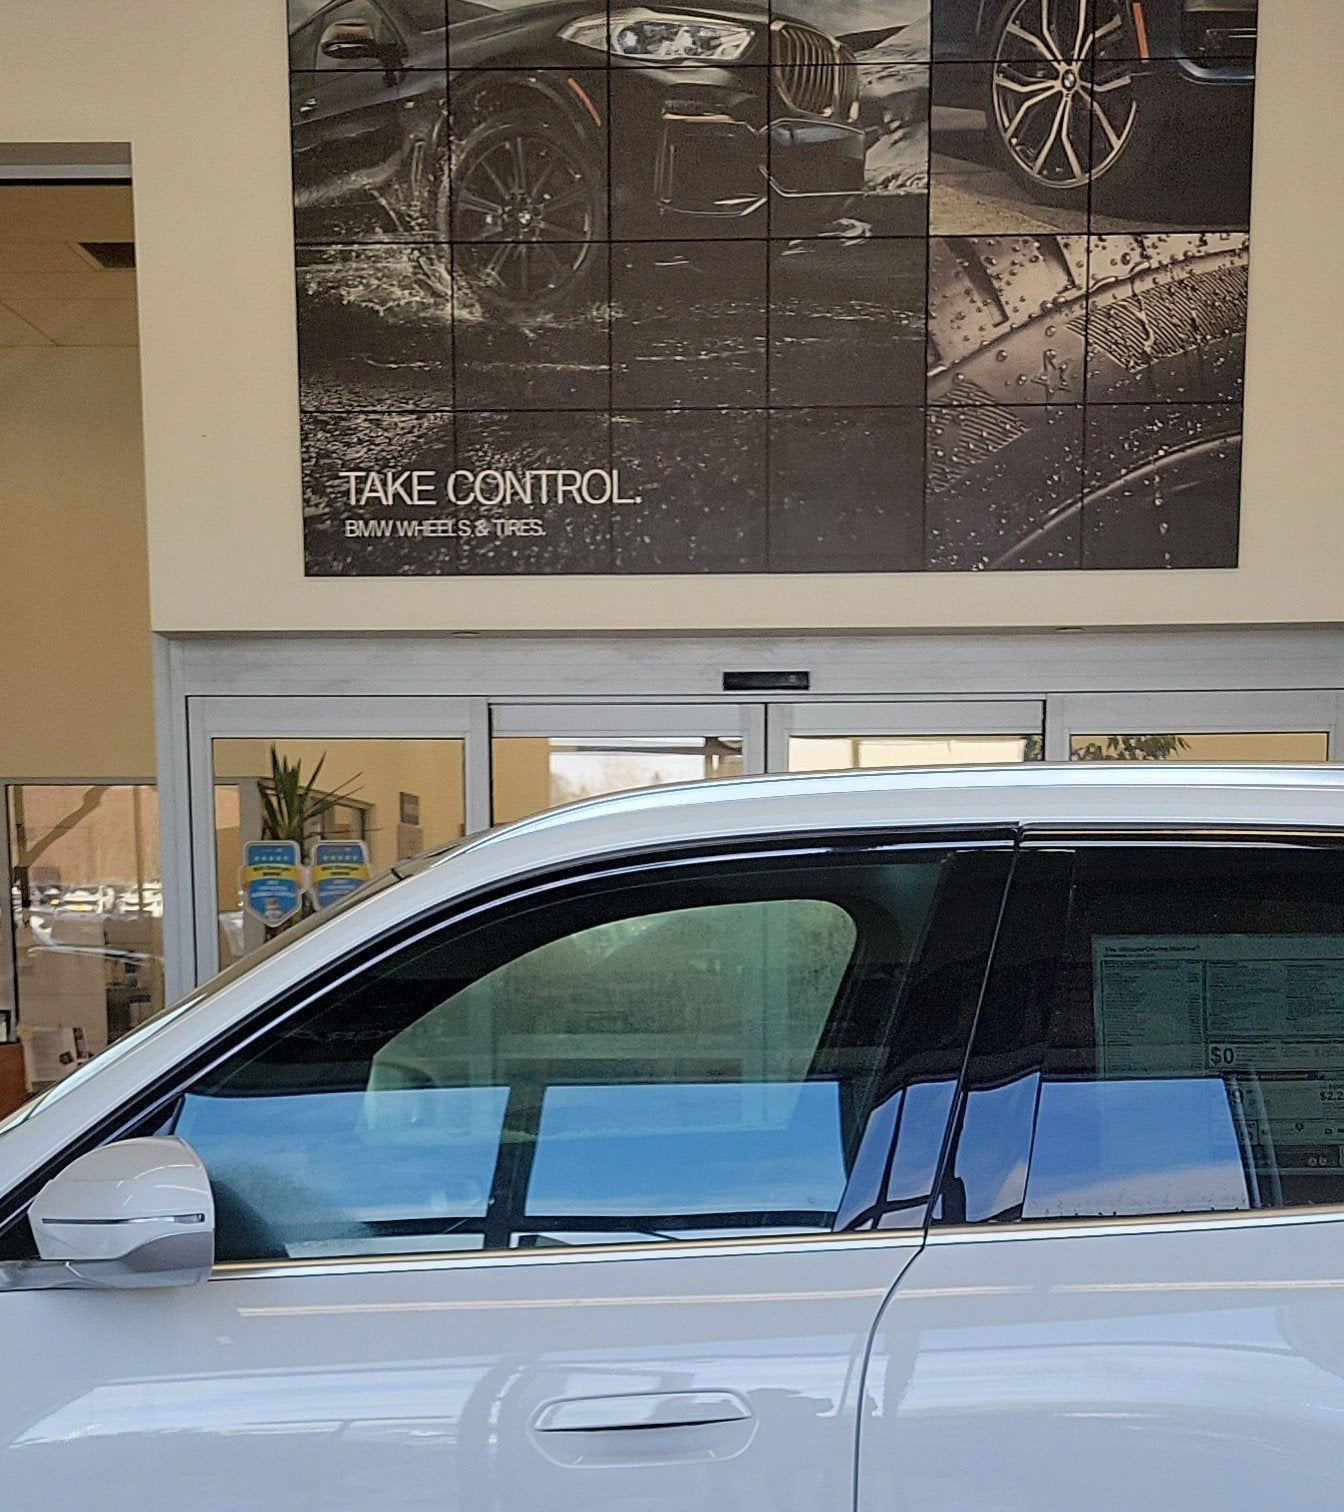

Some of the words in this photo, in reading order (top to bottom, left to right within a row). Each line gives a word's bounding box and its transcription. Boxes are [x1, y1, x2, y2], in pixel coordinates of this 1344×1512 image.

[338, 470, 436, 506] TAKE
[447, 469, 642, 505] CONTROL.
[345, 520, 392, 537] BMW
[396, 519, 472, 537] WHEELS
[474, 520, 490, 536] &
[492, 519, 547, 537] TIRES.
[1210, 1046, 1235, 1066] $0
